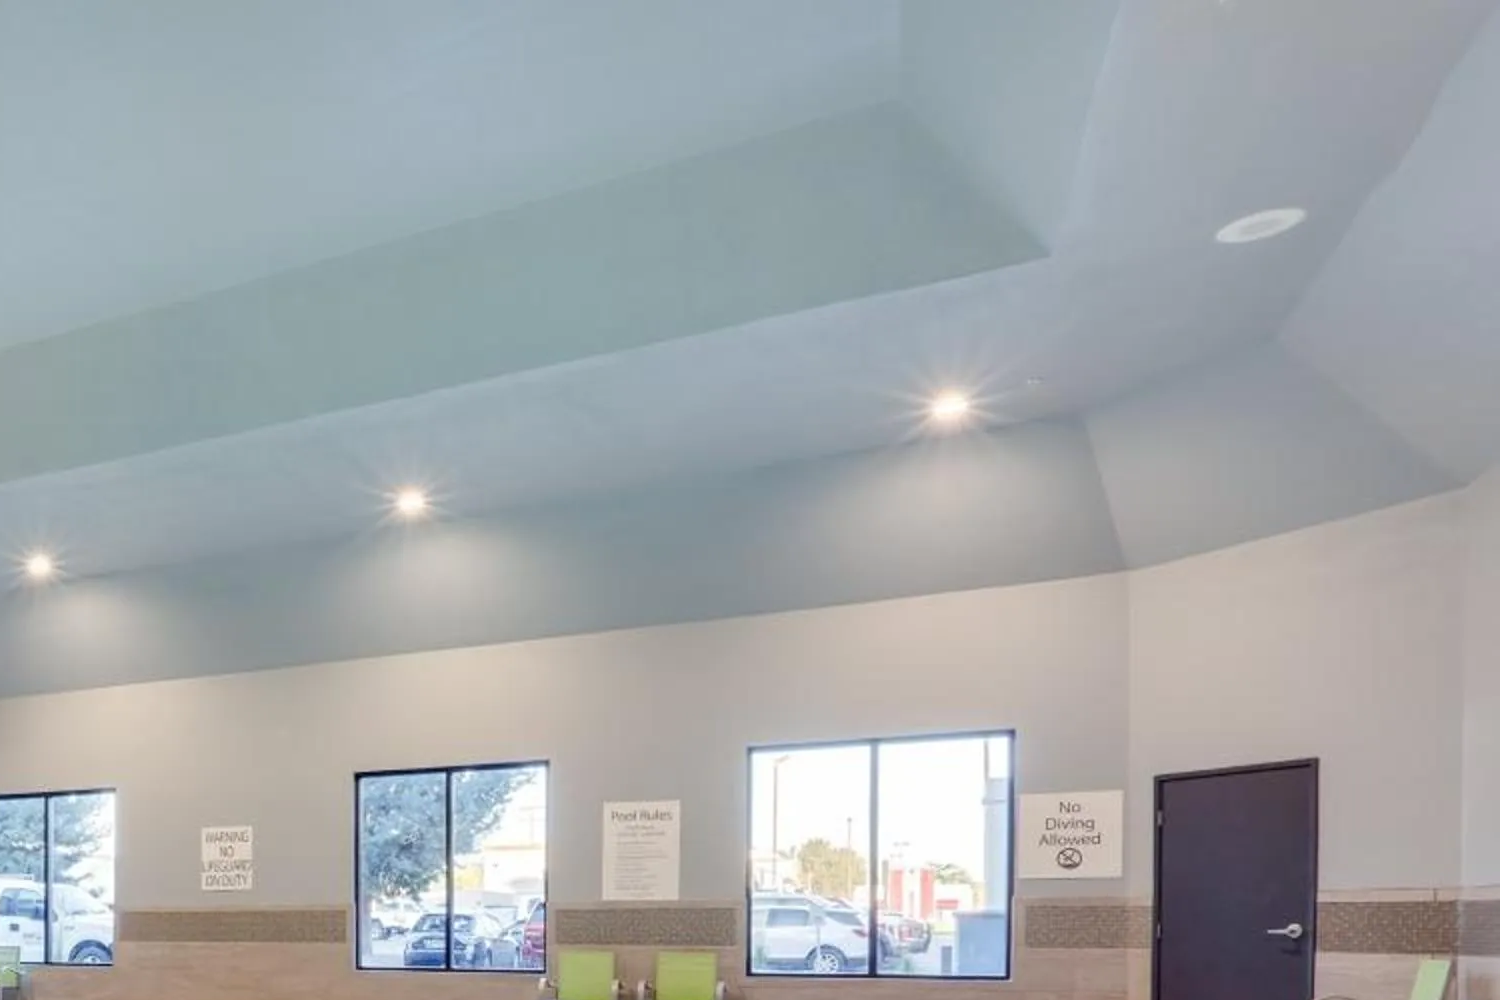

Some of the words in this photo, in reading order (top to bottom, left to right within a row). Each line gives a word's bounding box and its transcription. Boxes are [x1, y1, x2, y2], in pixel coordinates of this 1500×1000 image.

[1059, 800, 1082, 813] No
[1045, 817, 1095, 832] Diving
[1039, 832, 1102, 846] Allowed
[219, 845, 235, 857] NO
